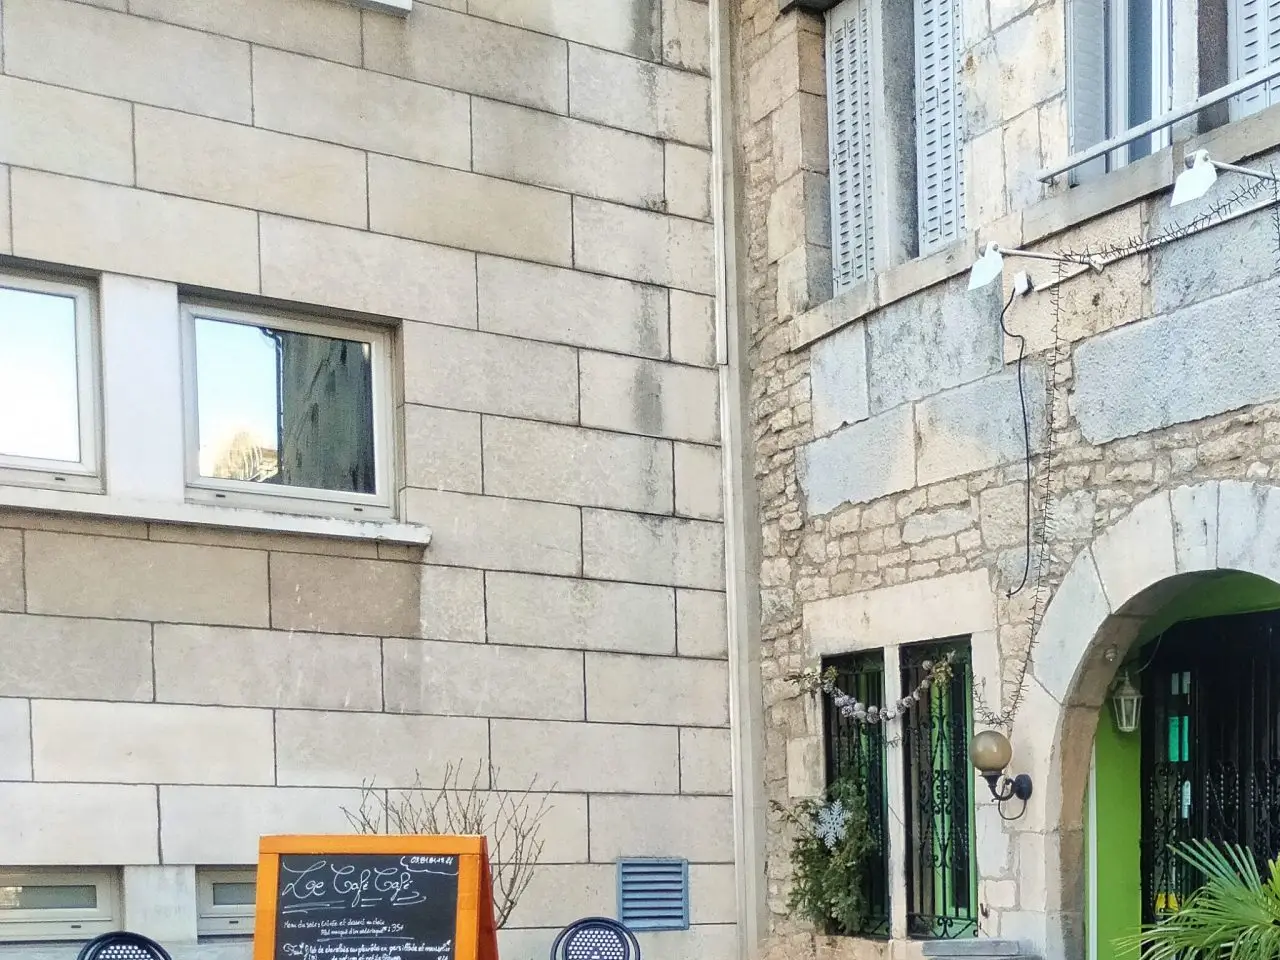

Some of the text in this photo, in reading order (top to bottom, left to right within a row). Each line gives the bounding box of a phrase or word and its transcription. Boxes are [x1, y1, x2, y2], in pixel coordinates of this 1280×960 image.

[331, 866, 371, 908] Café
[374, 867, 413, 902] Café
[284, 920, 297, 928] Menu
[298, 920, 306, 928] du
[339, 918, 346, 926] et
[318, 945, 324, 953] de
